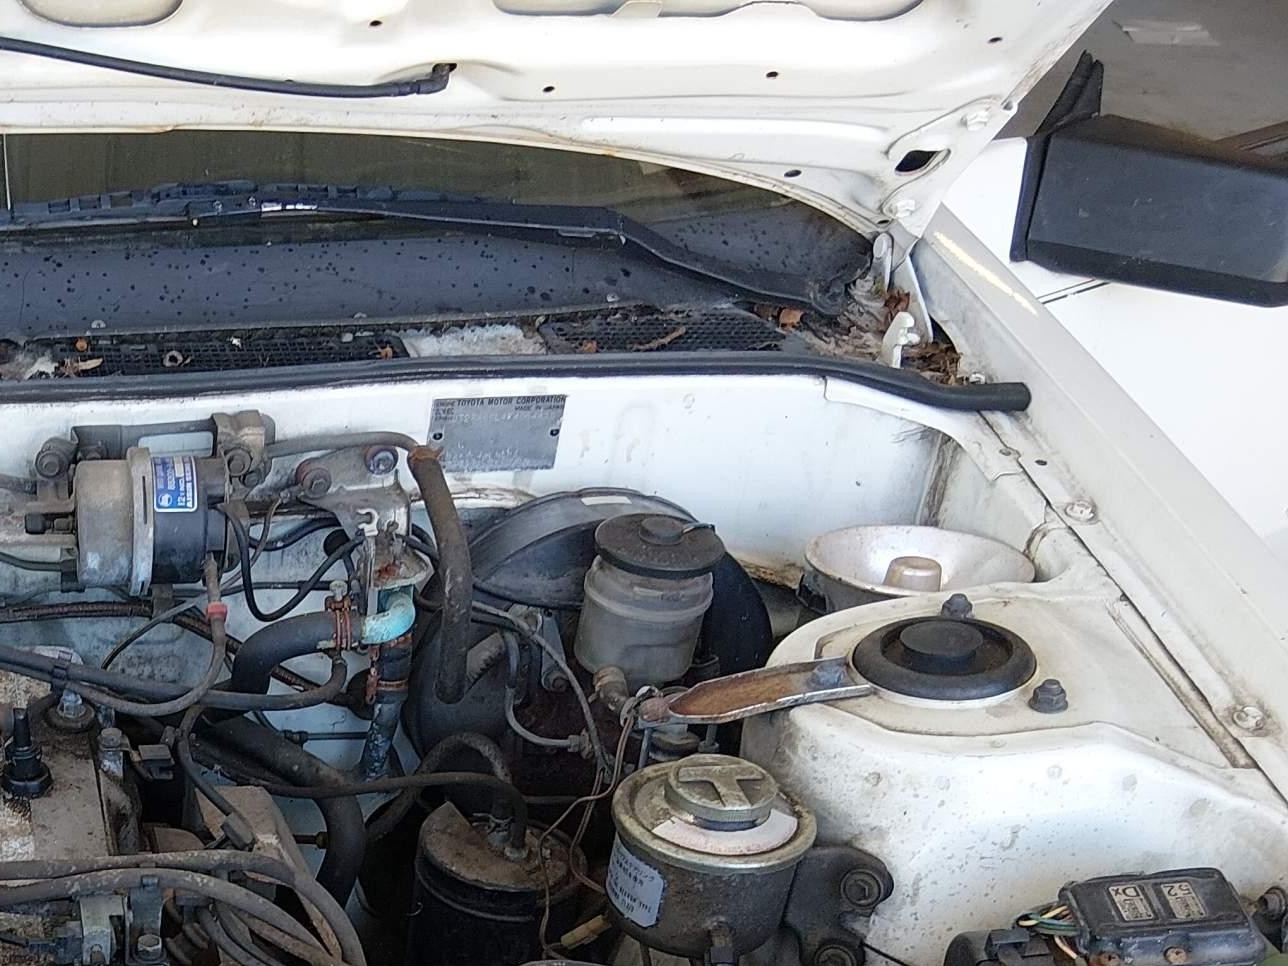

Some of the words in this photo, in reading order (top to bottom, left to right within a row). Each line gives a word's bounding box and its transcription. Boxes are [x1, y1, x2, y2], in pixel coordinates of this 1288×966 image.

[457, 399, 484, 407] TOYOTA
[488, 398, 513, 406] MOTOR
[516, 395, 566, 405] CORPORATION
[1163, 884, 1192, 897] 52
